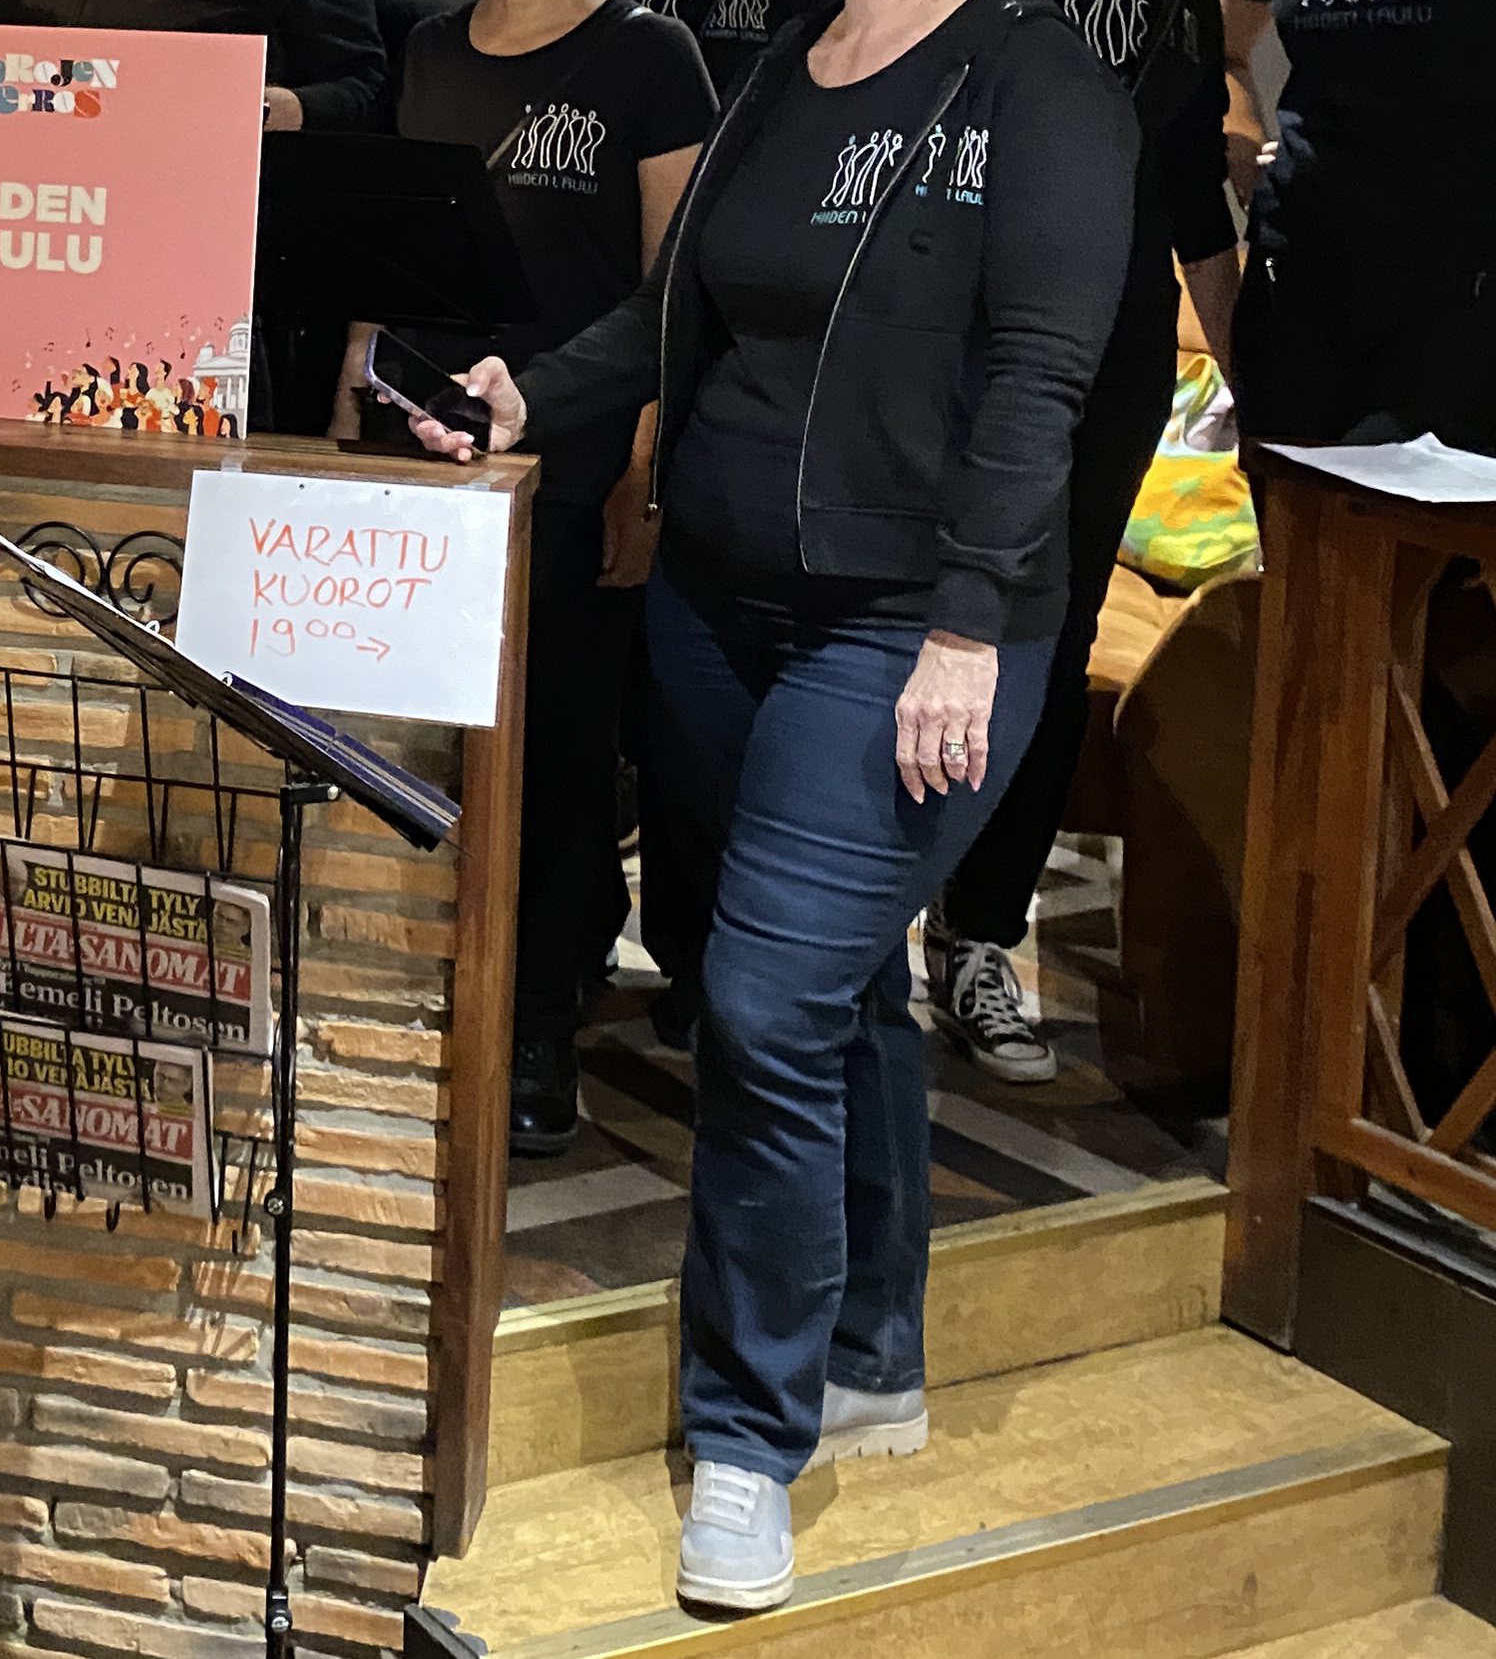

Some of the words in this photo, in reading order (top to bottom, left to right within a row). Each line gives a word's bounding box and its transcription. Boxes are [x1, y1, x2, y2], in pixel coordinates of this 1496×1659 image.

[249, 516, 450, 572] VARATTU
[253, 569, 432, 611] KUOROT
[148, 888, 201, 917] TYLY
